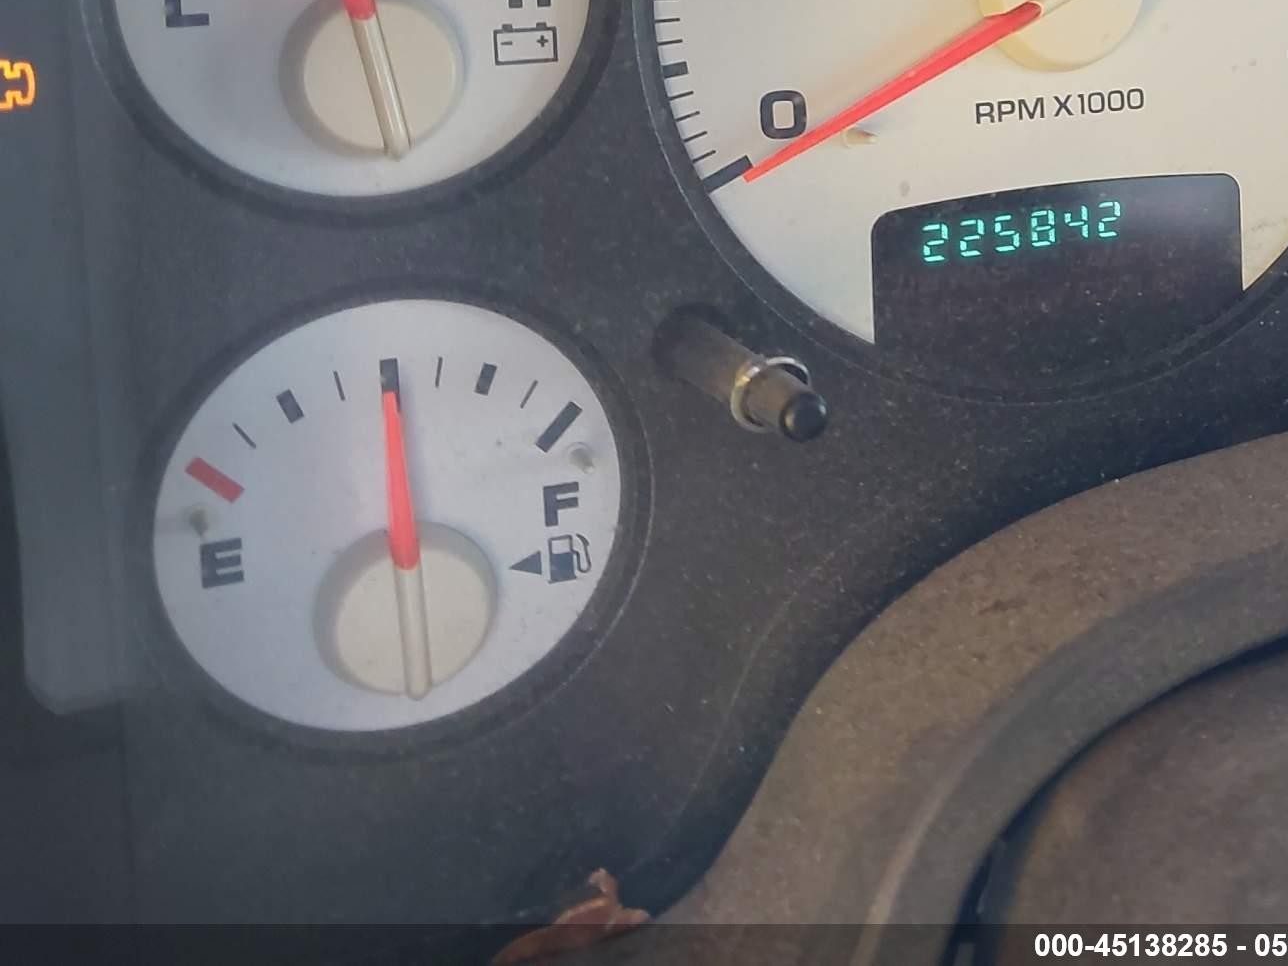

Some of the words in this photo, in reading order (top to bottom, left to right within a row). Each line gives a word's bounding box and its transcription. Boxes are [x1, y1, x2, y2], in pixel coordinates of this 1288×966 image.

[759, 89, 807, 140] 0
[975, 97, 1045, 125] RPM
[1053, 88, 1145, 118] X1000
[921, 201, 1121, 264] 225842
[542, 481, 580, 528] F
[199, 537, 245, 589] E
